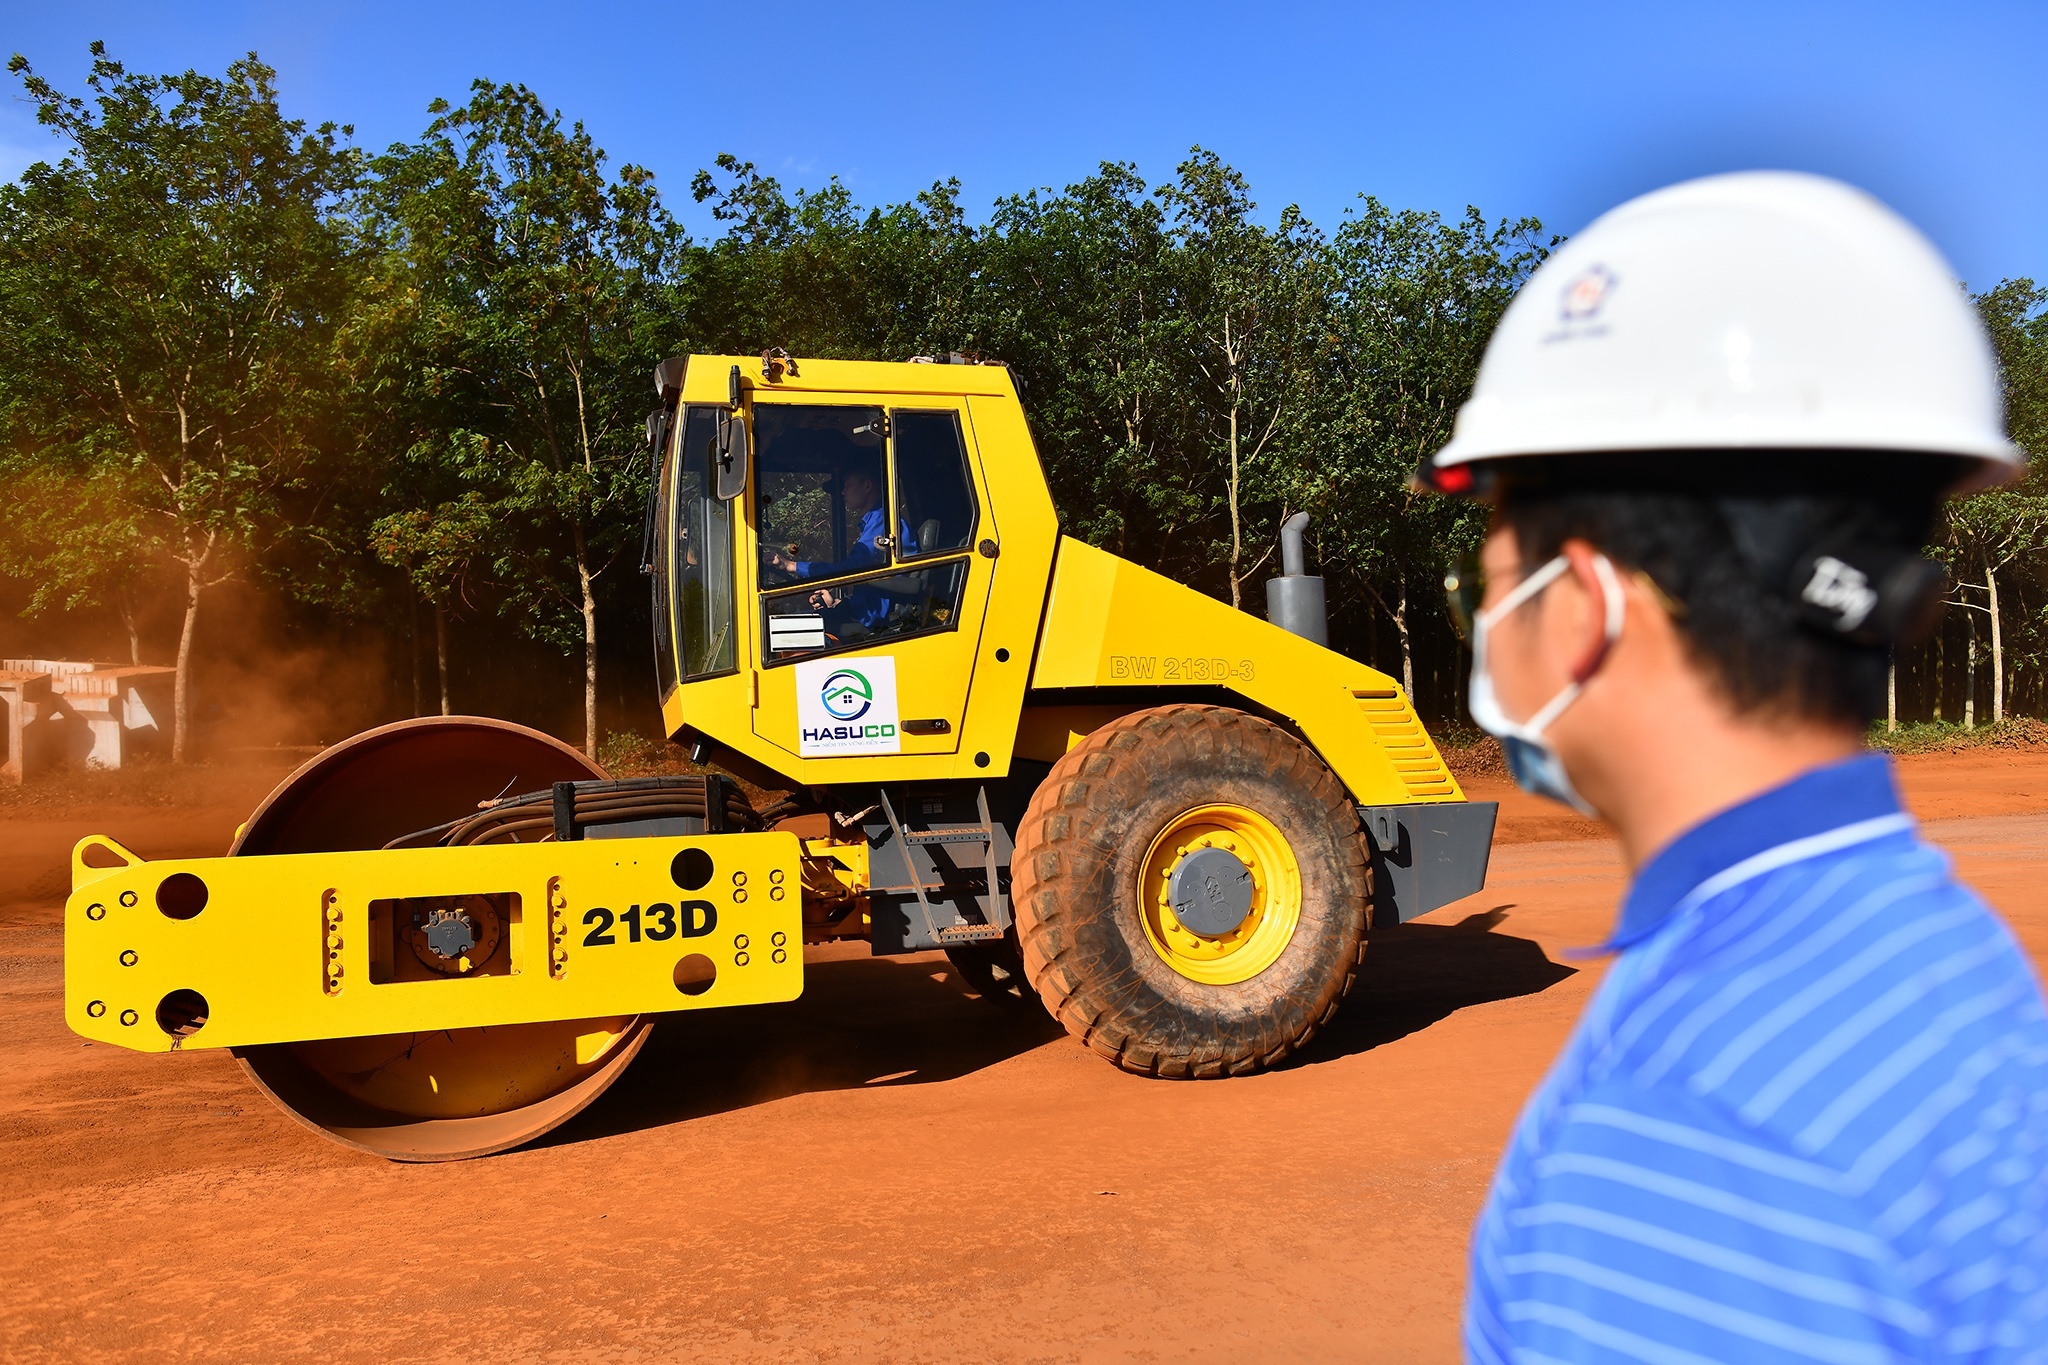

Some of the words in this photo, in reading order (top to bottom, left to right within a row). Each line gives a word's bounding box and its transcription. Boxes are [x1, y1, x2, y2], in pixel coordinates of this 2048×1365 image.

[1110, 656, 1156, 679] BW
[1163, 657, 1256, 682] 213D-3
[803, 724, 895, 741] HASUCO
[582, 900, 718, 947] 213D
